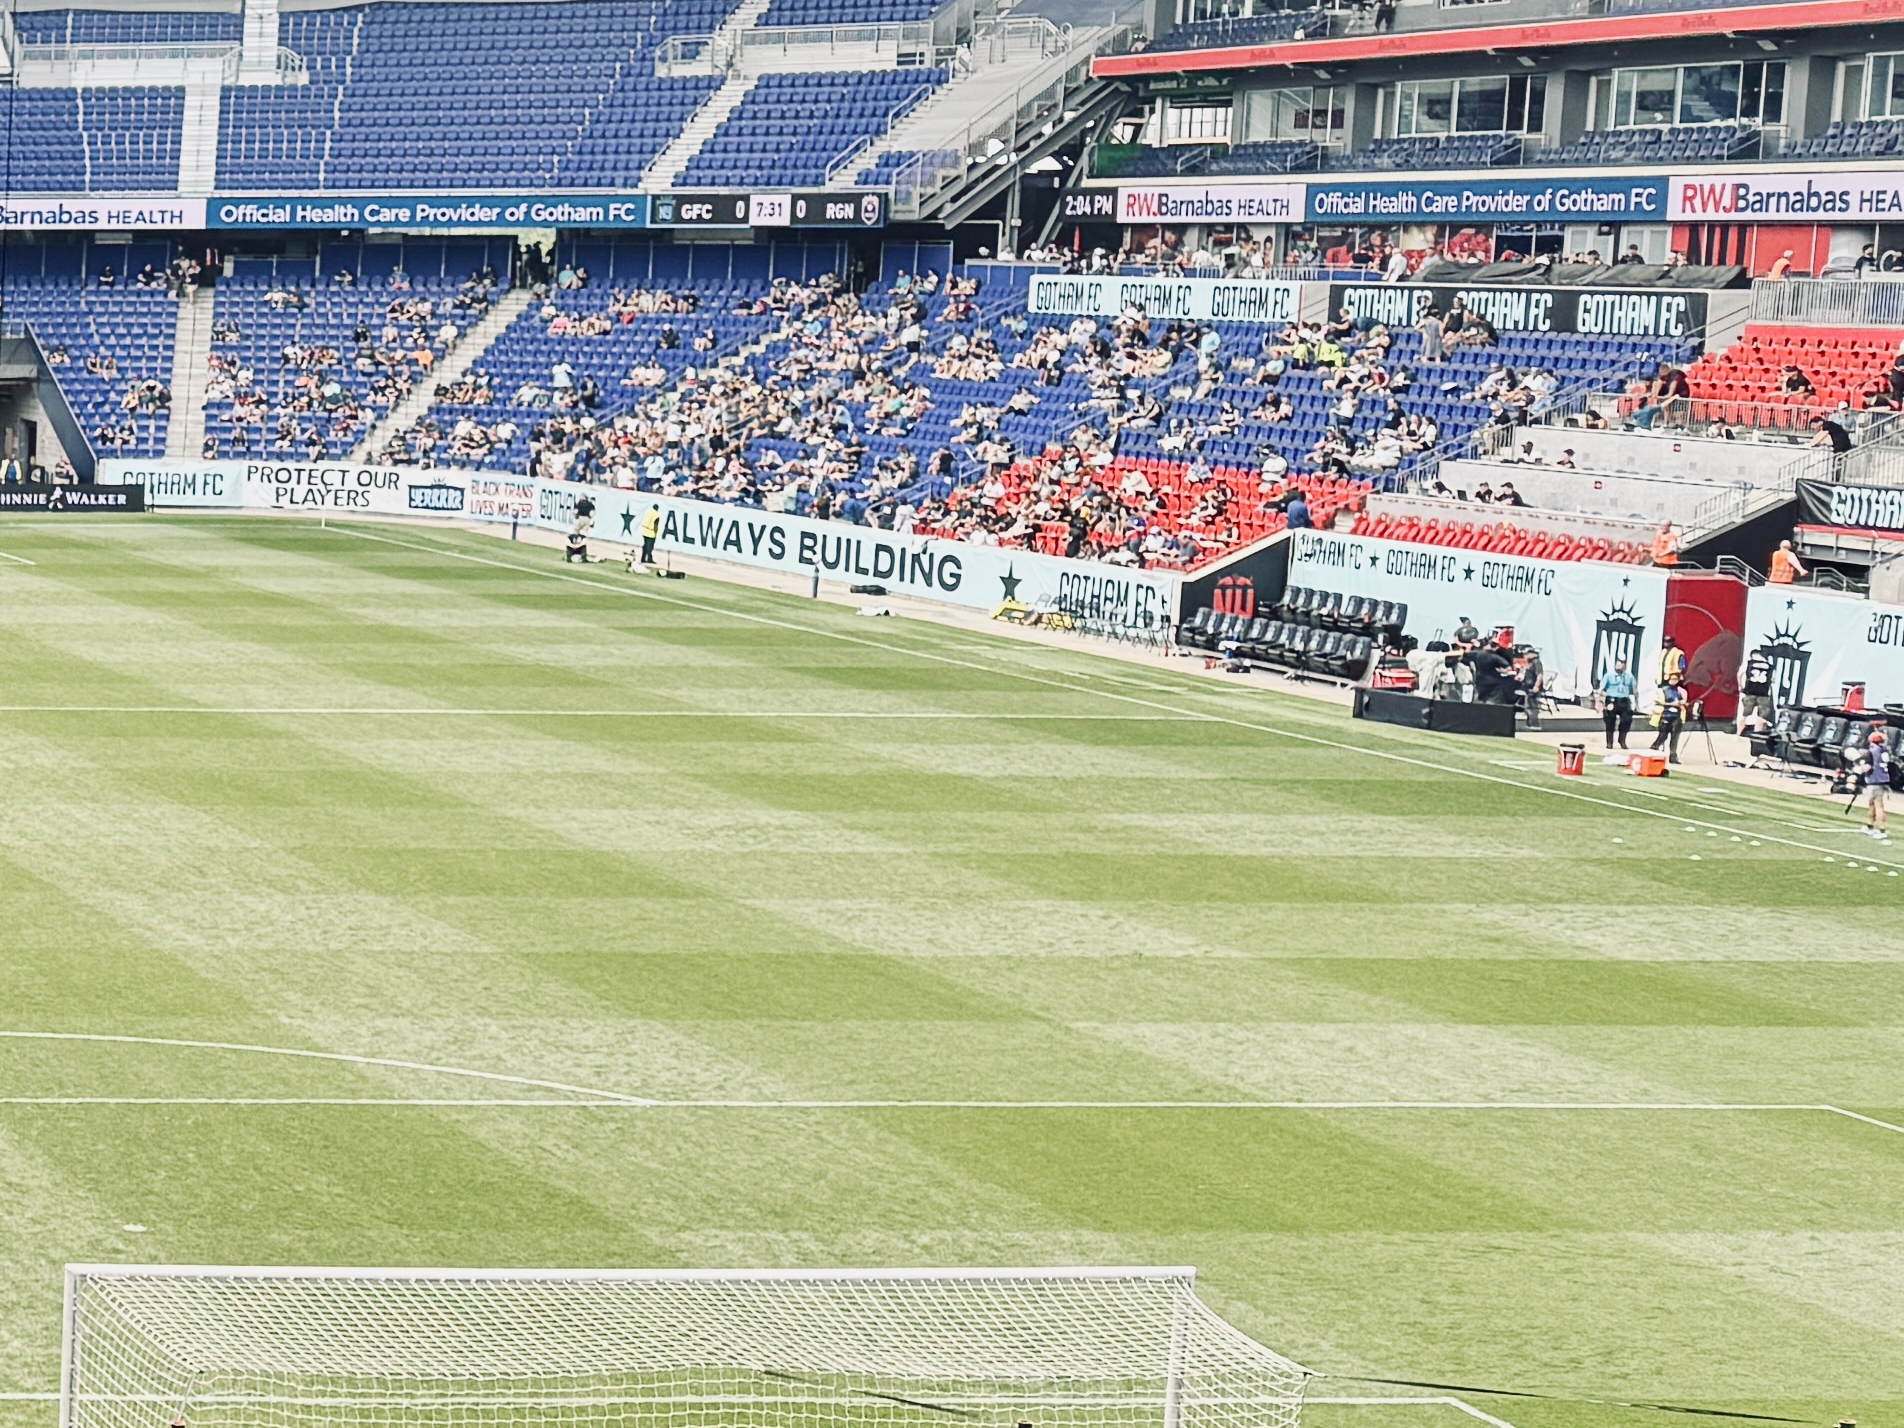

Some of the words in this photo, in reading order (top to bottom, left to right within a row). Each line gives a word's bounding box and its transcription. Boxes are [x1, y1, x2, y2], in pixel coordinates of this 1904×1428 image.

[219, 204, 291, 223] Official
[296, 204, 360, 223] Health
[363, 205, 411, 223] Care
[415, 203, 499, 223] Provider
[504, 203, 528, 222] of
[530, 203, 604, 222] Gotham
[608, 204, 635, 222] FC
[680, 203, 713, 220] GFC
[735, 200, 746, 219] 0
[756, 202, 783, 218] 7:31
[796, 199, 807, 219] 0
[825, 202, 855, 220] RGN
[1064, 196, 1092, 216] 2:04
[1092, 195, 1113, 215] PM
[1237, 198, 1290, 217] HEALTH
[1314, 190, 1366, 215] Official
[1368, 190, 1418, 215] Health
[1421, 189, 1458, 213] Care
[1461, 188, 1530, 213] Provider
[1533, 188, 1553, 212] of
[1555, 187, 1626, 212] Gotham
[1629, 187, 1657, 211] FC
[107, 209, 183, 225] HEALTH
[1036, 281, 1084, 311] GOTHAM
[1088, 282, 1102, 312] FC
[1120, 283, 1173, 315] GOTHAM
[1175, 284, 1192, 316] FC
[1211, 285, 1269, 318] GOTHAM
[1273, 287, 1291, 319] FC
[1577, 293, 1657, 335] GOTHAM
[1662, 295, 1686, 336] FC
[203, 474, 224, 497] FC
[247, 464, 351, 487] PROTECT
[357, 469, 400, 490] OUR
[471, 479, 501, 497] BLACK
[504, 482, 534, 500] TRANS
[274, 486, 371, 507] PLAYERS
[470, 500, 494, 516] LIVES
[661, 509, 787, 561] ALWAYS
[798, 530, 963, 593] BUILDING
[1349, 544, 1363, 570] FC
[1385, 548, 1438, 582] GOTHAM
[1441, 556, 1457, 583] FC
[1481, 560, 1536, 594] GOTHAM
[1538, 569, 1556, 596] FC
[1058, 571, 1130, 624] GOTHAM
